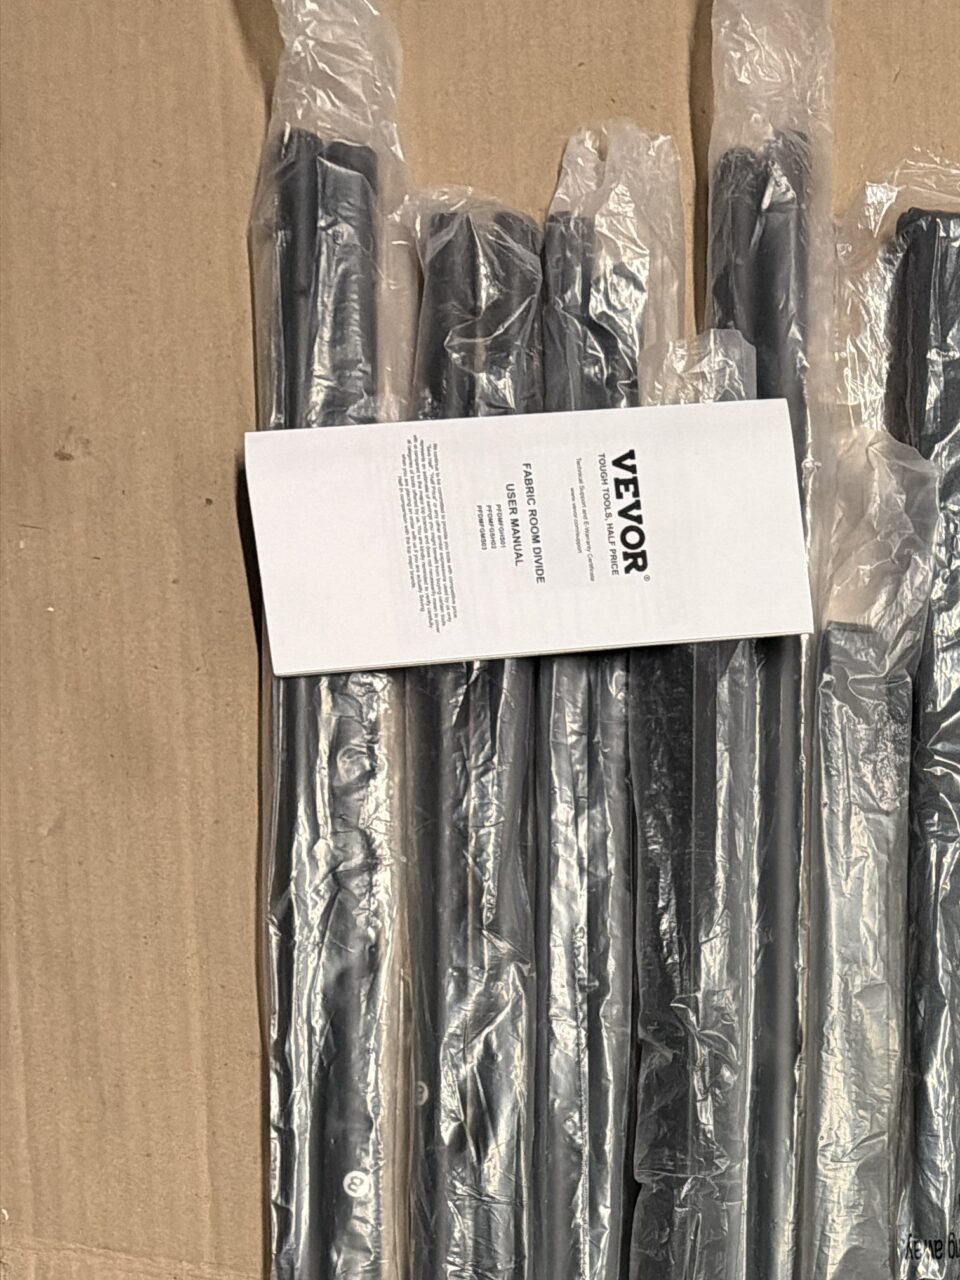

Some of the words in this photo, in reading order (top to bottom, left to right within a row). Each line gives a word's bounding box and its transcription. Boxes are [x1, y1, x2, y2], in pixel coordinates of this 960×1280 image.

[522, 462, 535, 505] FABRIC
[598, 452, 608, 485] TOUGH
[505, 483, 517, 515] USER
[602, 487, 612, 520] TOOLS,
[611, 449, 648, 574] VEVOR
[528, 508, 540, 543] ROOM
[570, 487, 582, 553] www.vevor.com/support
[578, 484, 586, 507] Support
[583, 520, 591, 552] E-Warranty
[606, 522, 615, 545] HALF
[510, 518, 523, 566] MANUAL
[532, 546, 545, 583] DIVIDE
[609, 548, 619, 575] PRICE
